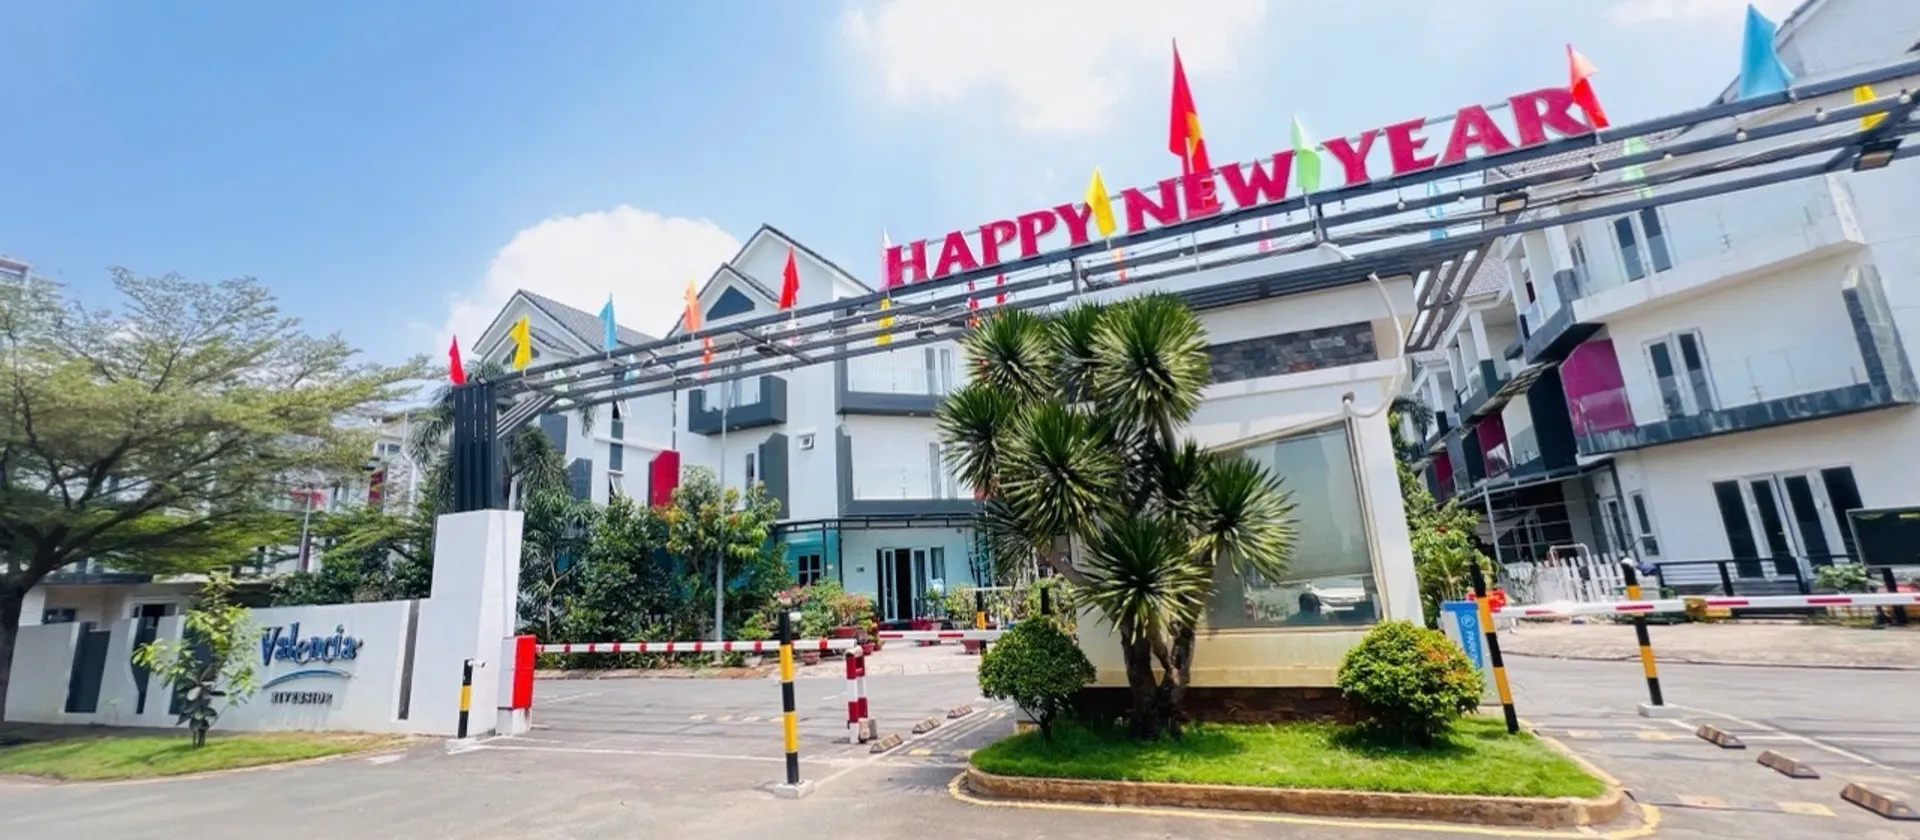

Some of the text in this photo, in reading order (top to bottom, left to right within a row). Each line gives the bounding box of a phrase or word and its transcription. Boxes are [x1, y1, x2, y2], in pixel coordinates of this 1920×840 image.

[885, 87, 1590, 288] HAPPY NEW YEAR
[261, 621, 363, 667] Valencia
